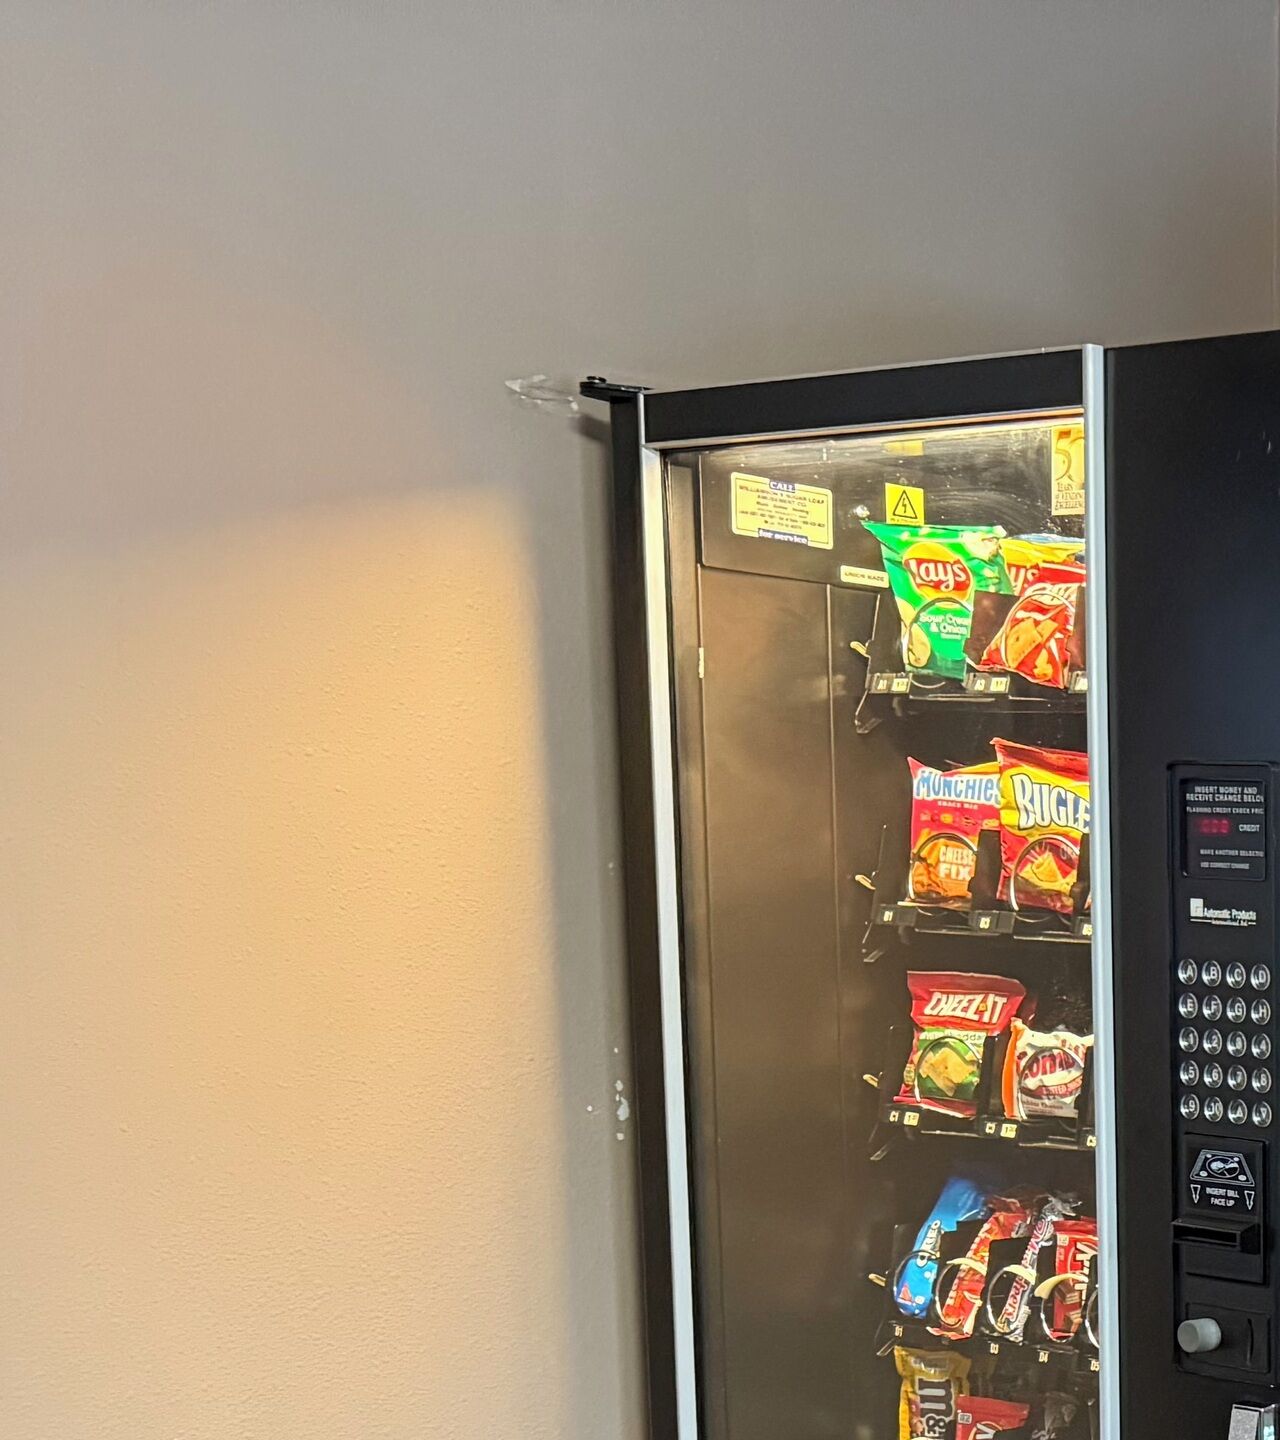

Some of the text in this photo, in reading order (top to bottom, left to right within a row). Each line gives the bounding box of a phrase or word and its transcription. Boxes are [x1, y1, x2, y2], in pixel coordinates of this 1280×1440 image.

[770, 481, 795, 492] CALL
[758, 530, 808, 544] for service
[909, 558, 967, 591] Lay's
[914, 769, 1001, 806] MUNCHIES
[1195, 786, 1218, 794] INSERT
[1010, 773, 1091, 833] BUGLE
[1186, 793, 1241, 802] RECEIVE CHANGE
[1239, 824, 1260, 832] CREDIT
[939, 846, 975, 865] CHEESE
[939, 864, 971, 880] FIX
[1232, 909, 1256, 920] Products
[1187, 965, 1266, 982] A B C D
[1187, 999, 1267, 1018] E F G H
[1190, 1033, 1267, 1051] 1 2 4
[1188, 1067, 1195, 1079] 5
[1212, 1069, 1219, 1081] 6
[1189, 1100, 1195, 1112] 9
[1206, 1187, 1240, 1198] INSERT BILL
[1211, 1197, 1225, 1206] FACE
